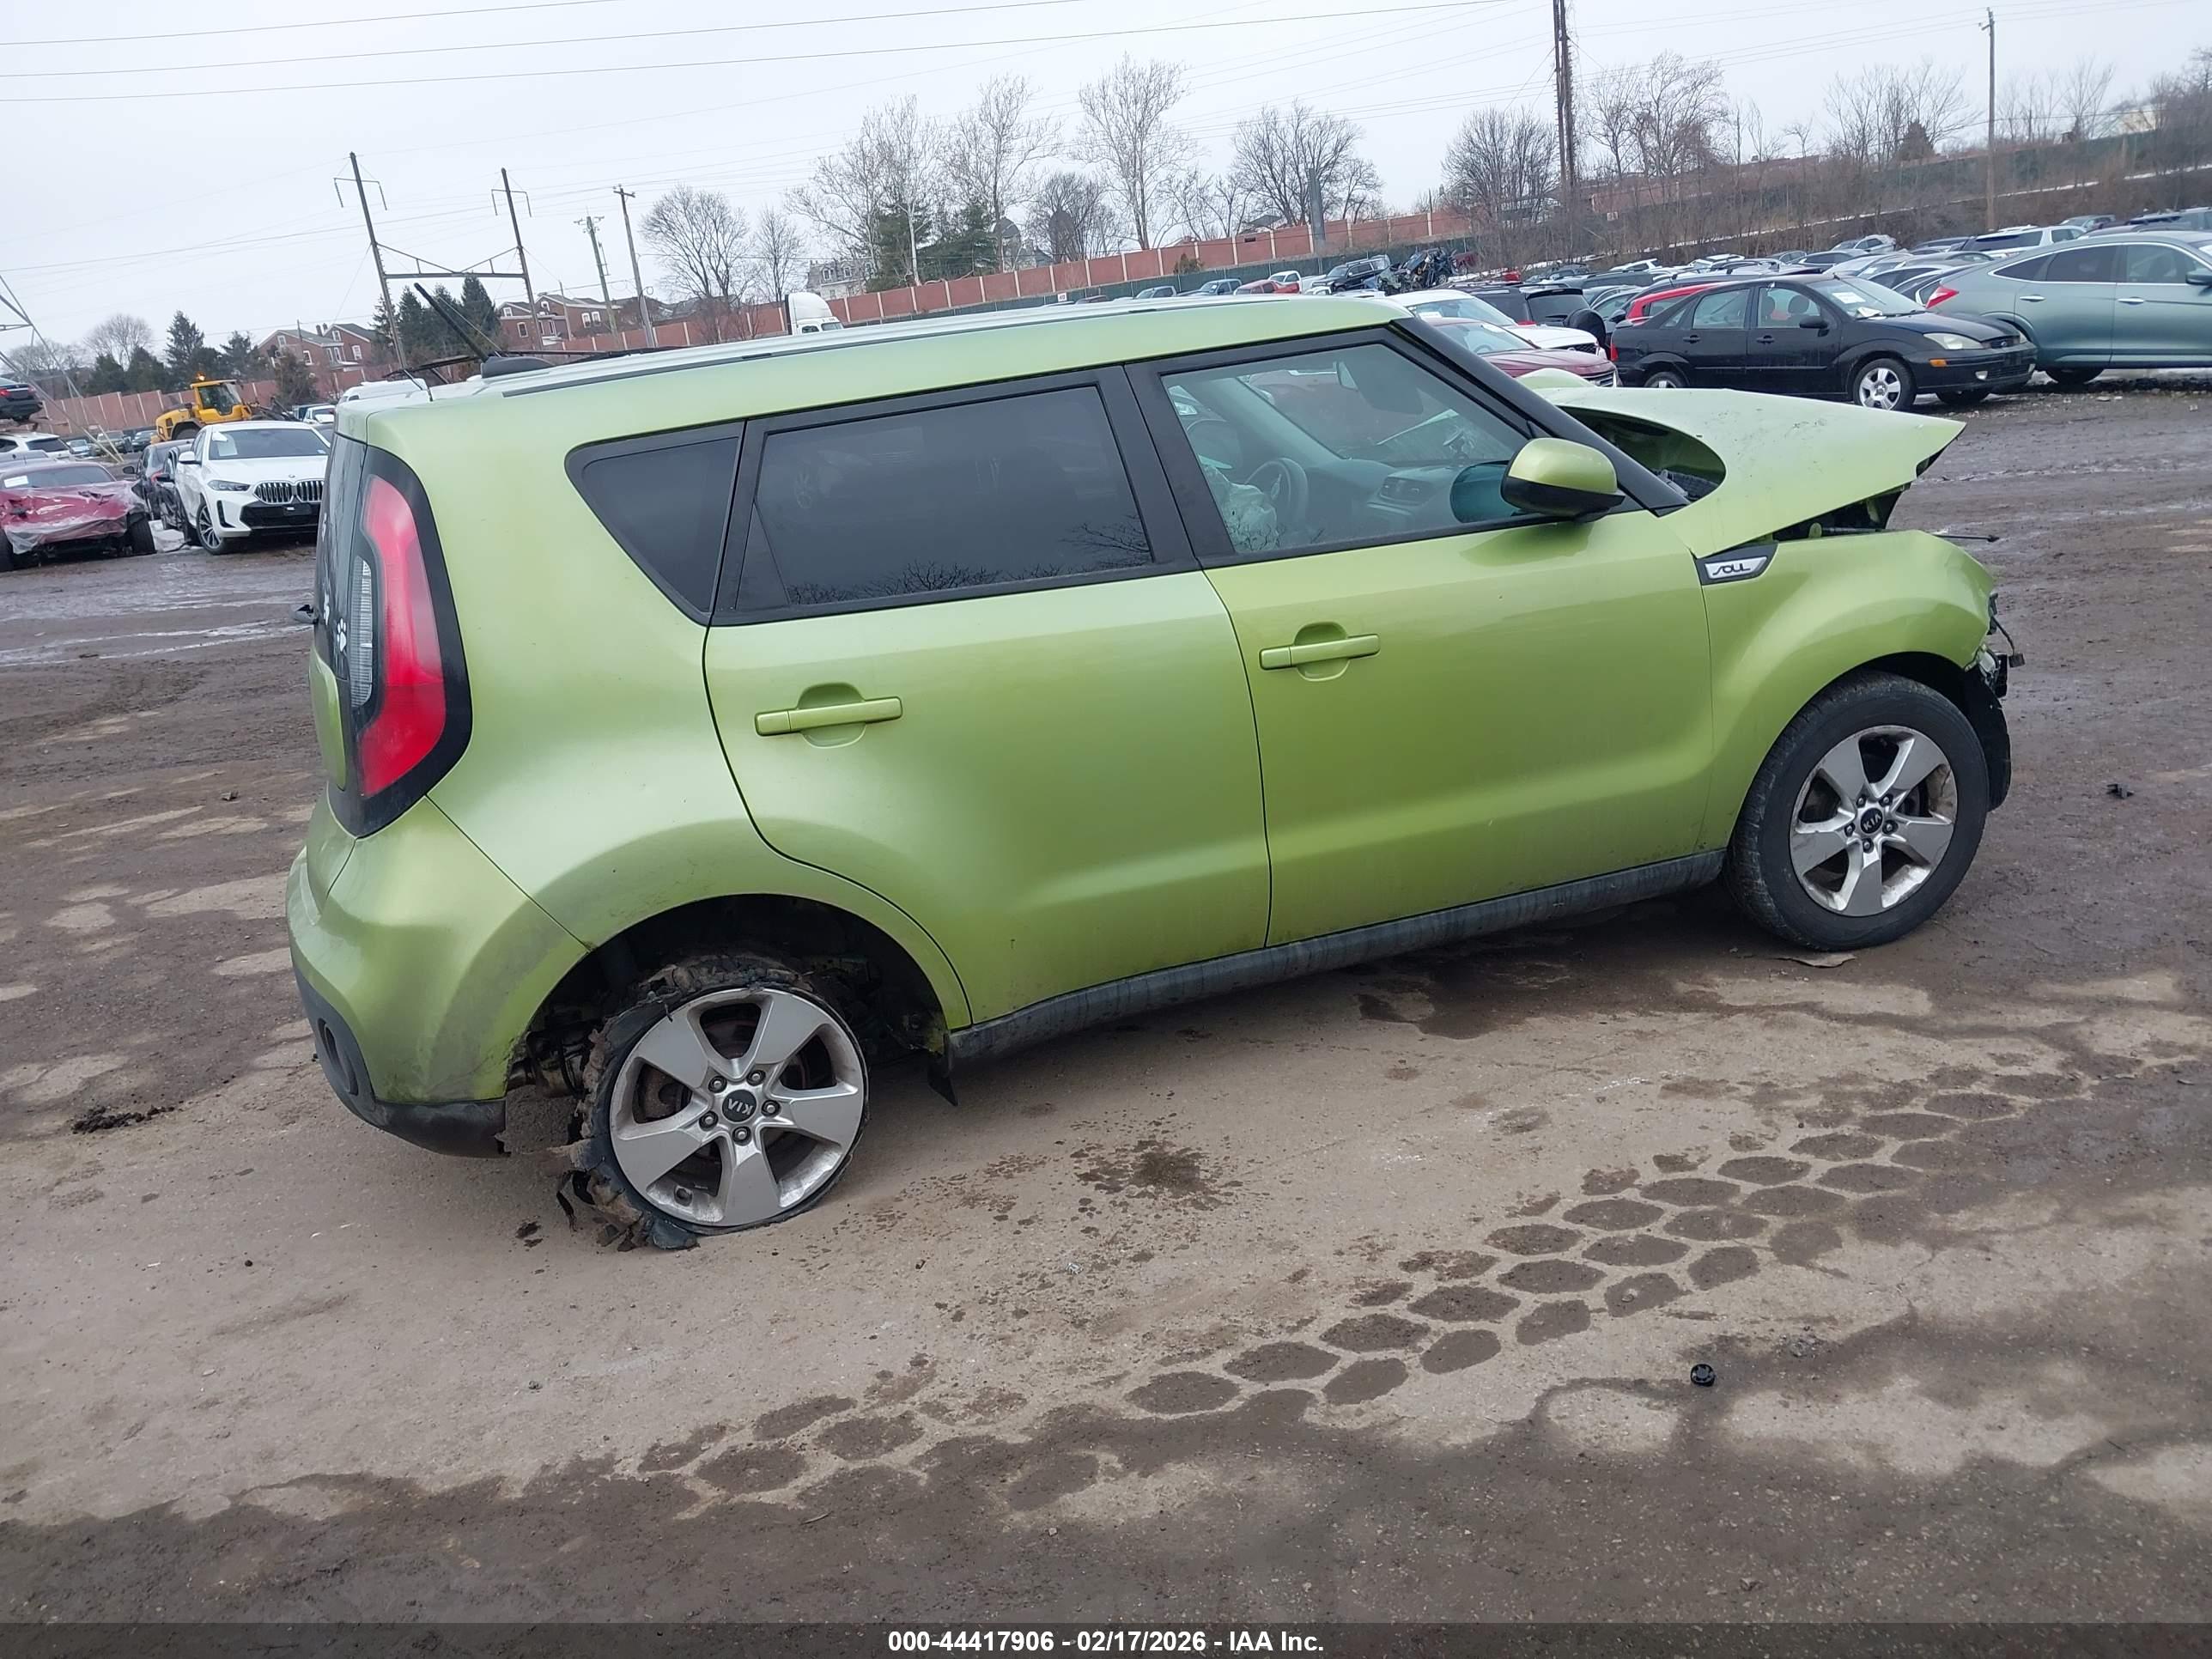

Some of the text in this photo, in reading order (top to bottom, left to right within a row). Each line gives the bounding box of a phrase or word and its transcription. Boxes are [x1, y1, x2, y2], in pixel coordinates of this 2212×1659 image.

[1712, 562, 1751, 575] SOUL
[1863, 813, 1881, 830] KIA
[728, 1098, 753, 1115] KIA
